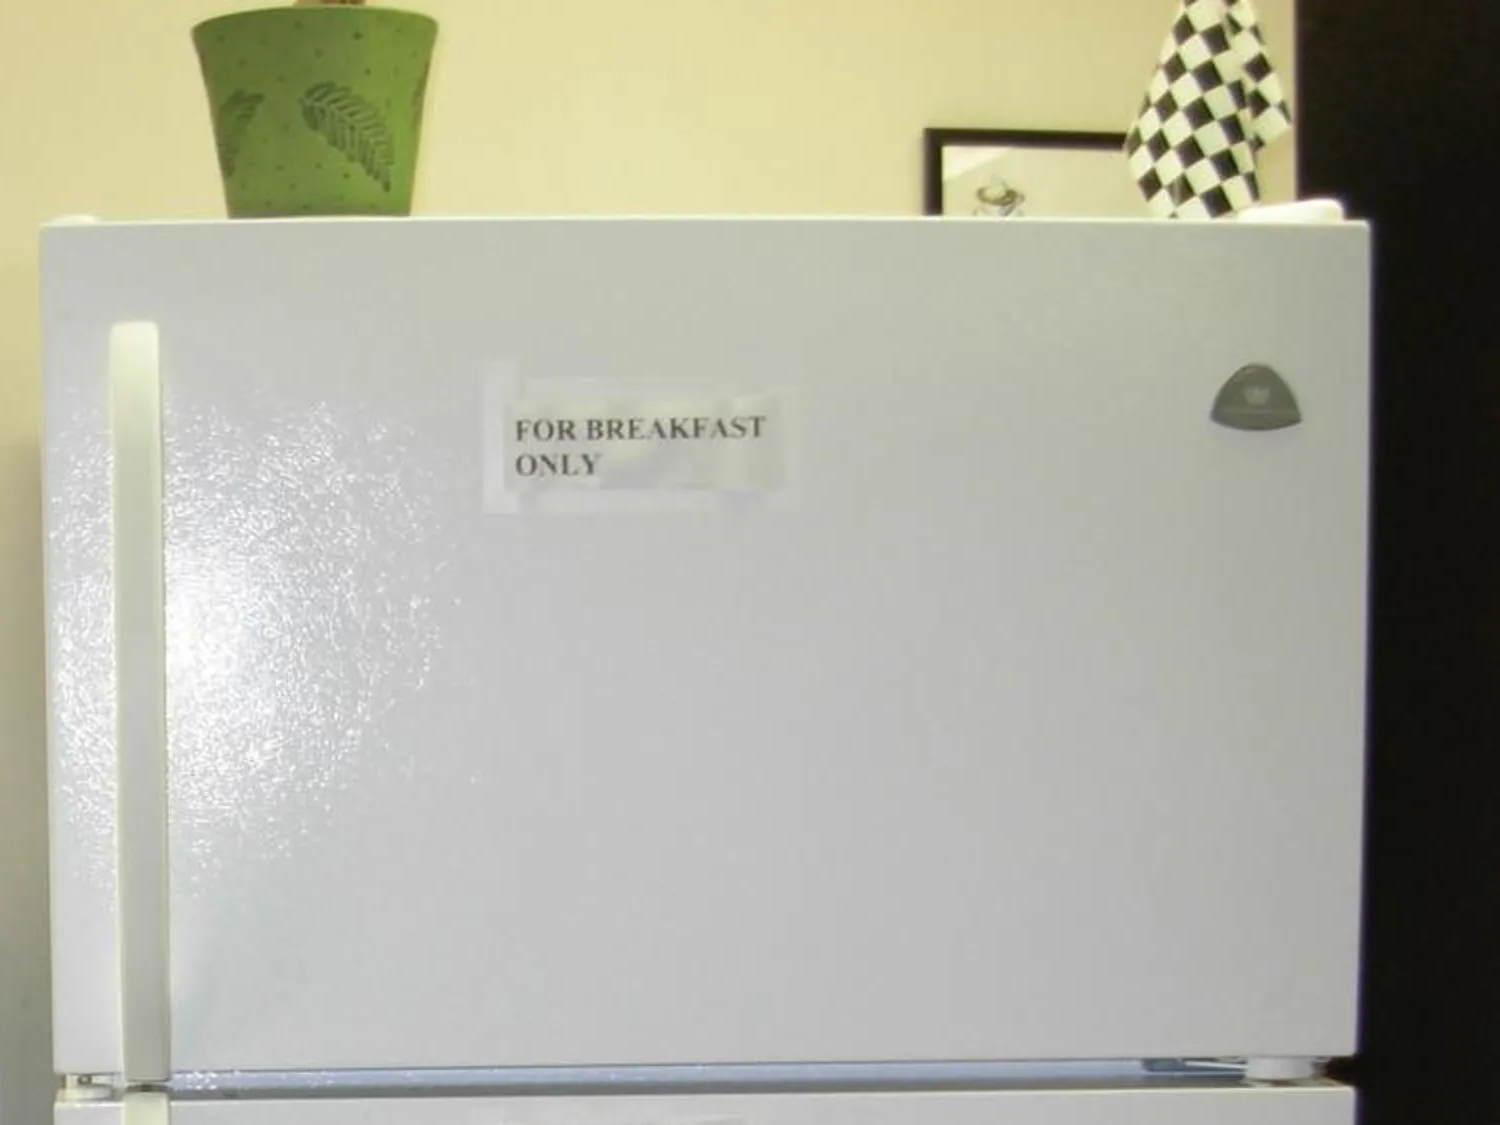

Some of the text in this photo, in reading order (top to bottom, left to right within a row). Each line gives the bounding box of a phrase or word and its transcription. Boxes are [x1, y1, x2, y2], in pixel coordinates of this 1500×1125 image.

[515, 416, 766, 441] FOR BREAKFAST
[515, 453, 602, 477] ONLY
